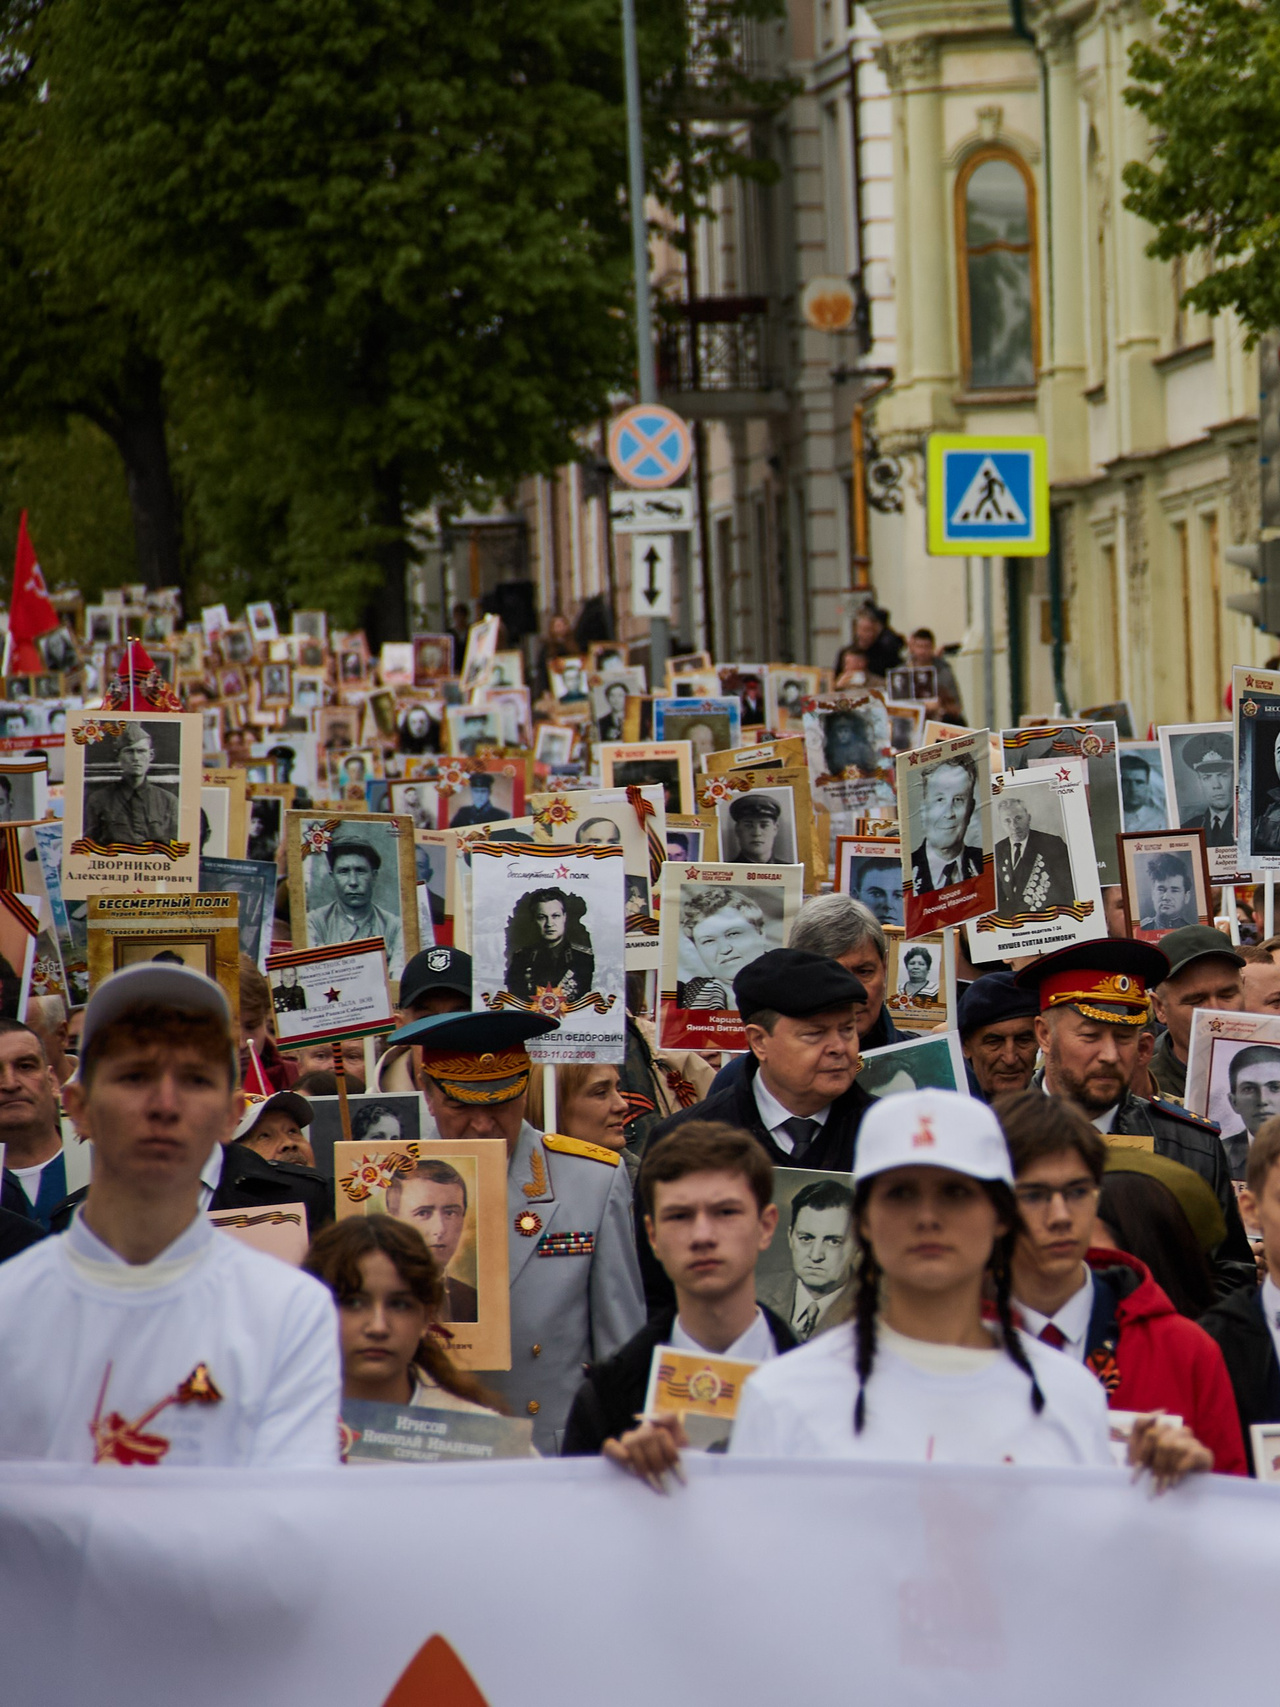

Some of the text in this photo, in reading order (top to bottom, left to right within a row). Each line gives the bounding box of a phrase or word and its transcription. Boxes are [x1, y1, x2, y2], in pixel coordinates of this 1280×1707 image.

[87, 860, 171, 871] ДВОРНИКОВ
[507, 862, 555, 880] бессмертный
[66, 872, 192, 883] Александр Иванович
[98, 896, 230, 909] БЕССМЕРТНЫЙ ПОЛК
[36, 961, 61, 973] Саби
[709, 1016, 742, 1024] Карцев
[686, 1024, 715, 1032] Янина
[565, 1033, 623, 1042] ФЕДОРОВИЧ
